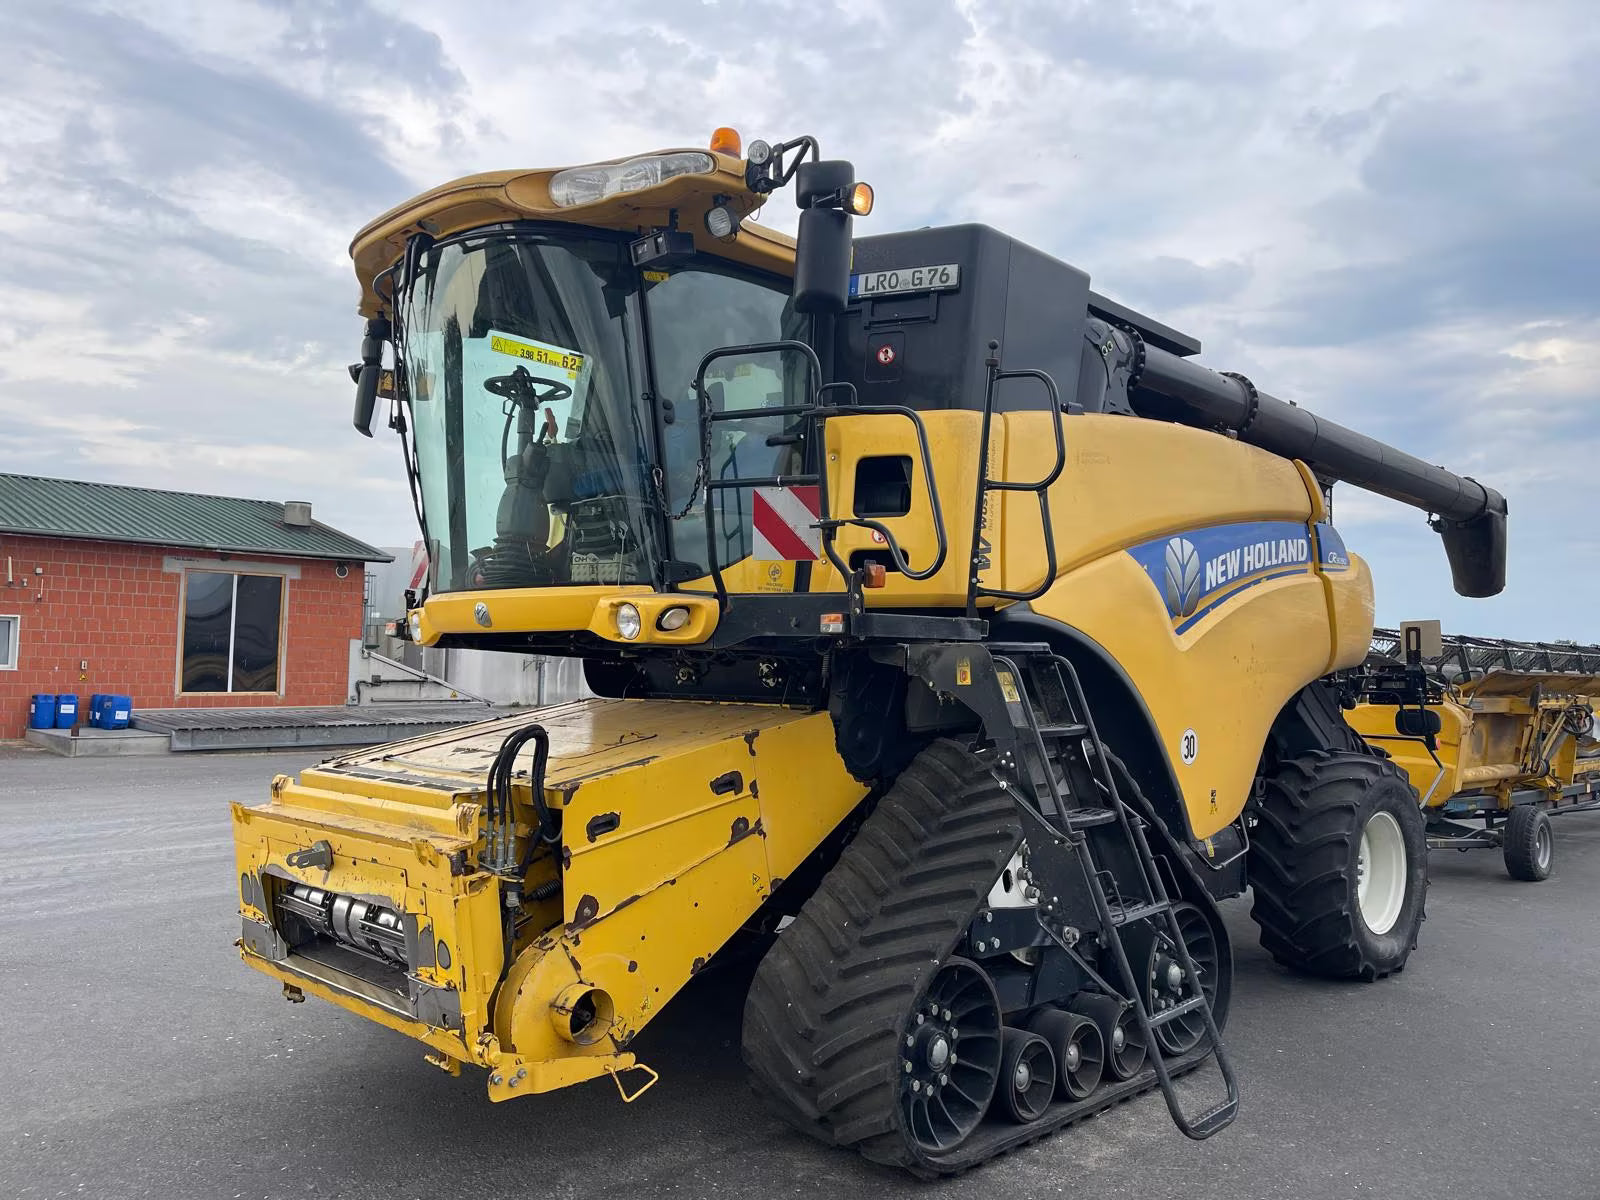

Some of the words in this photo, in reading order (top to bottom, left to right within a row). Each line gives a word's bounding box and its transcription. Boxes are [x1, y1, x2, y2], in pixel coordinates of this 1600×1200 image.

[864, 272, 899, 292] LRO
[1206, 549, 1240, 591] NEW
[1243, 538, 1307, 573] HOLLAND
[1184, 734, 1195, 759] 30
